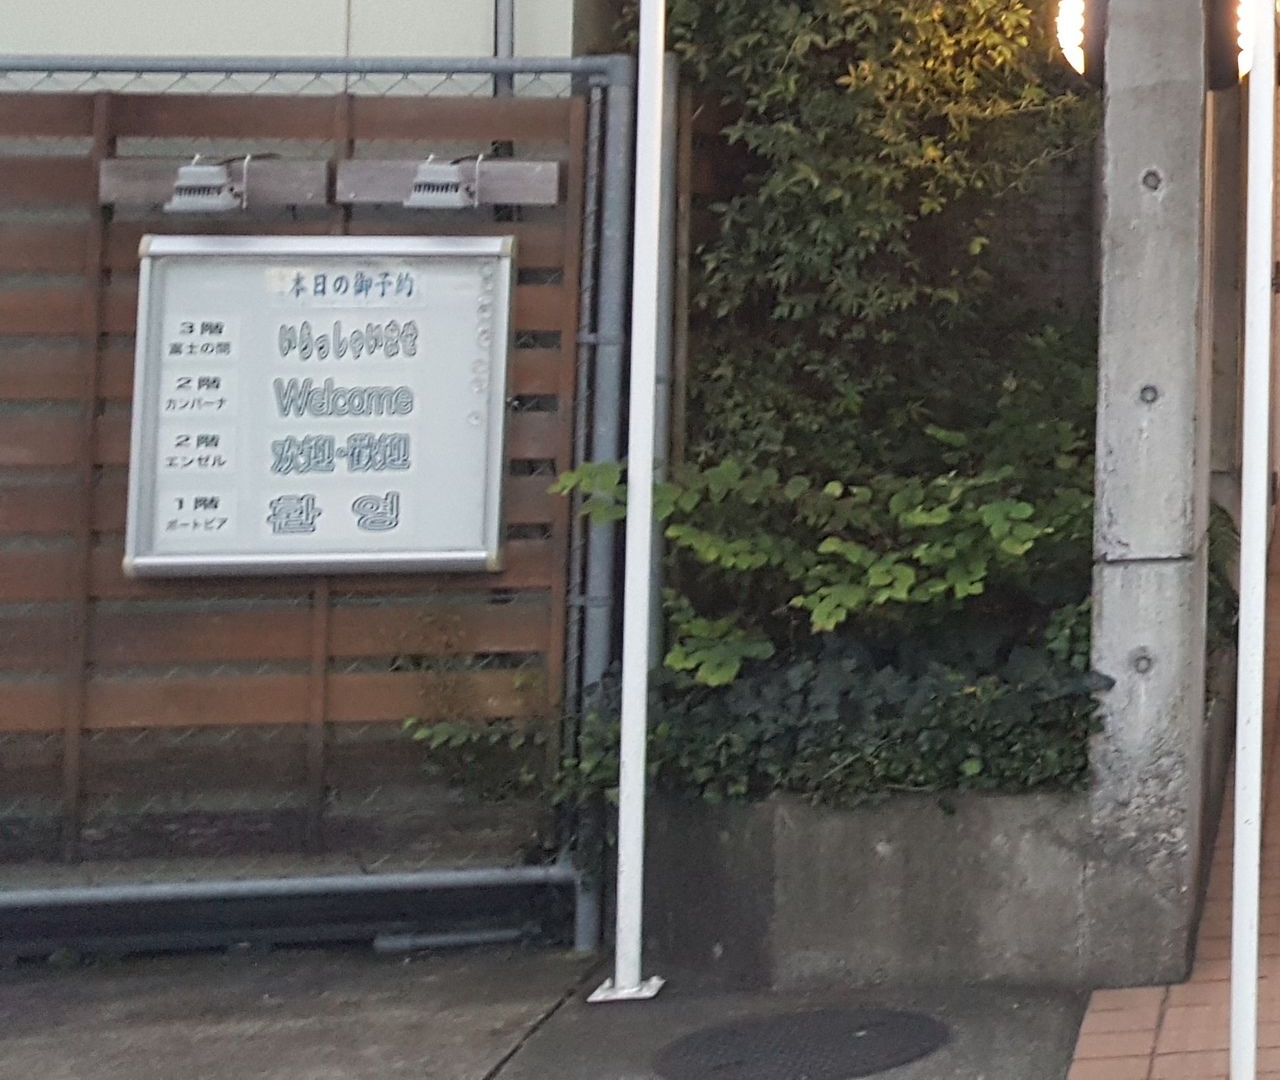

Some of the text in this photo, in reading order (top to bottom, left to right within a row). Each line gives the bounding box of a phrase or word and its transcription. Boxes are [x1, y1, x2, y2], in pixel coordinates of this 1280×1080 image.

[290, 271, 415, 298] 本日の御予約
[278, 319, 419, 361] いらっしゃいませ
[273, 377, 415, 417] Welcome
